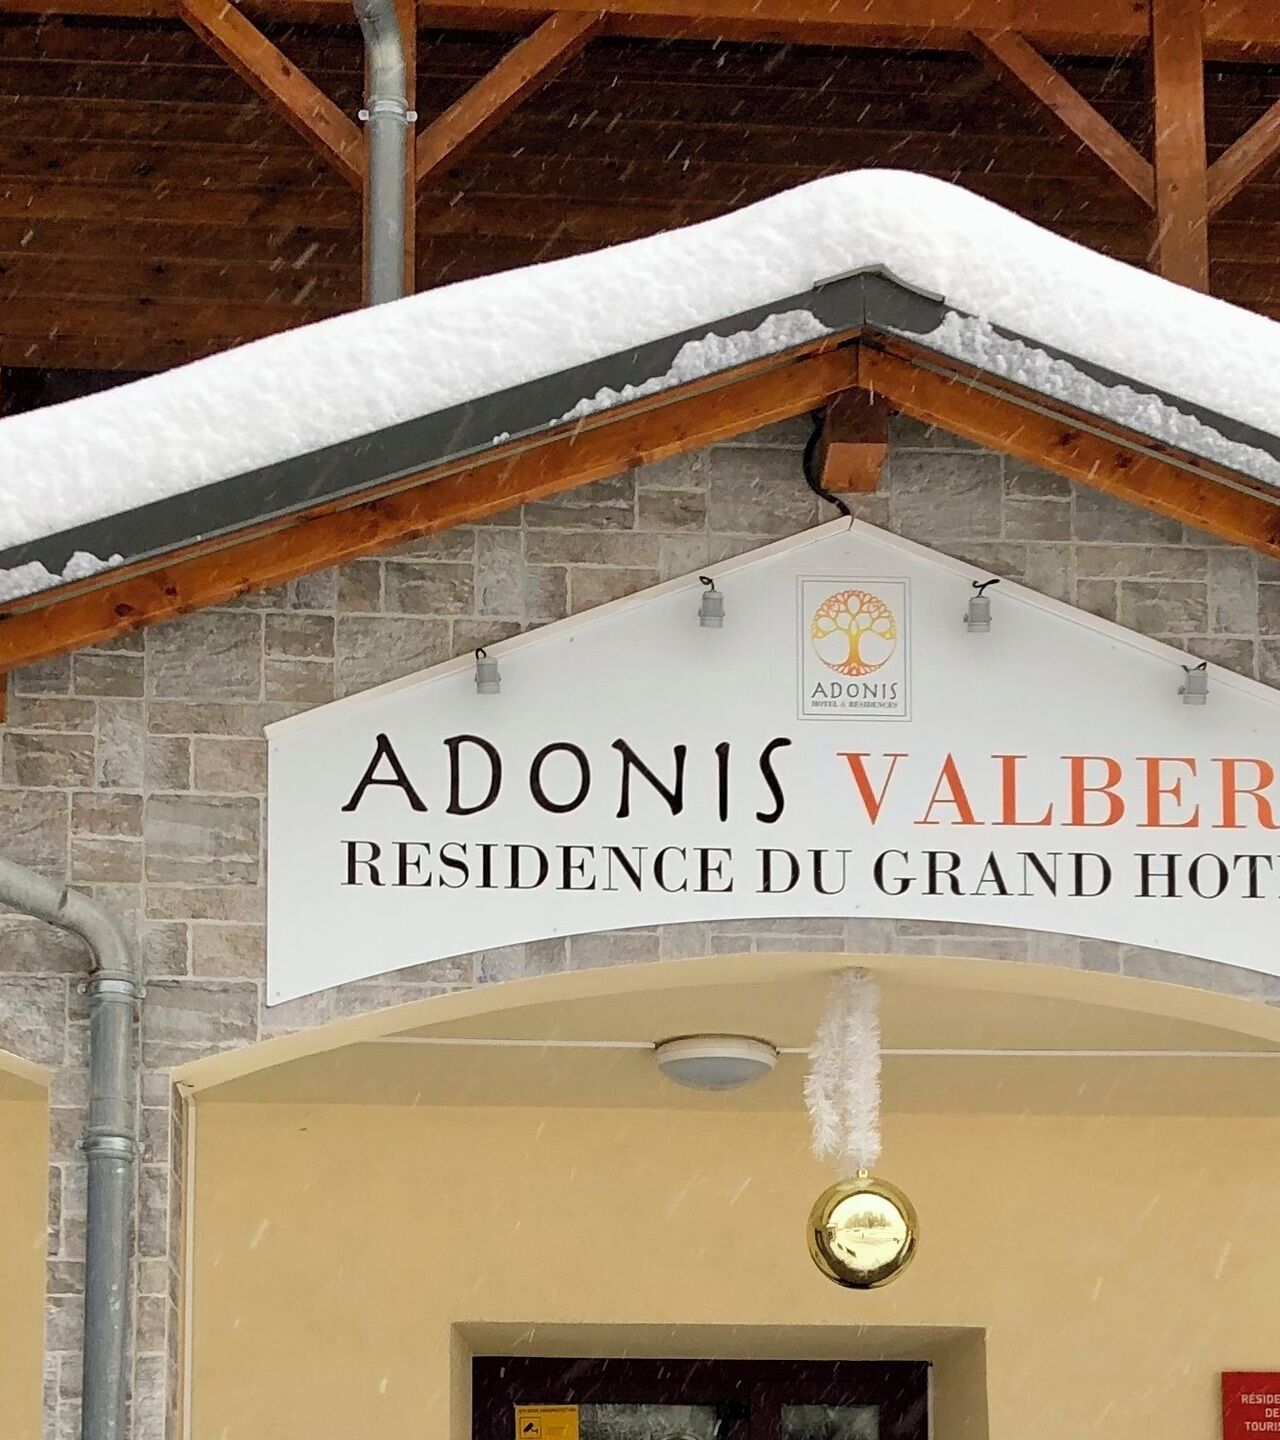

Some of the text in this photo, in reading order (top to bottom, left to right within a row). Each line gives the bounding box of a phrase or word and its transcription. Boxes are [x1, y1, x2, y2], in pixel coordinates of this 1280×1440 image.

[811, 681, 898, 699] ADONIS
[341, 733, 792, 824] ADONIS
[340, 839, 734, 895] RESIDENCE
[756, 848, 851, 896] DU
[872, 850, 1114, 899] GRAND
[1265, 1407, 1280, 1418] DE
